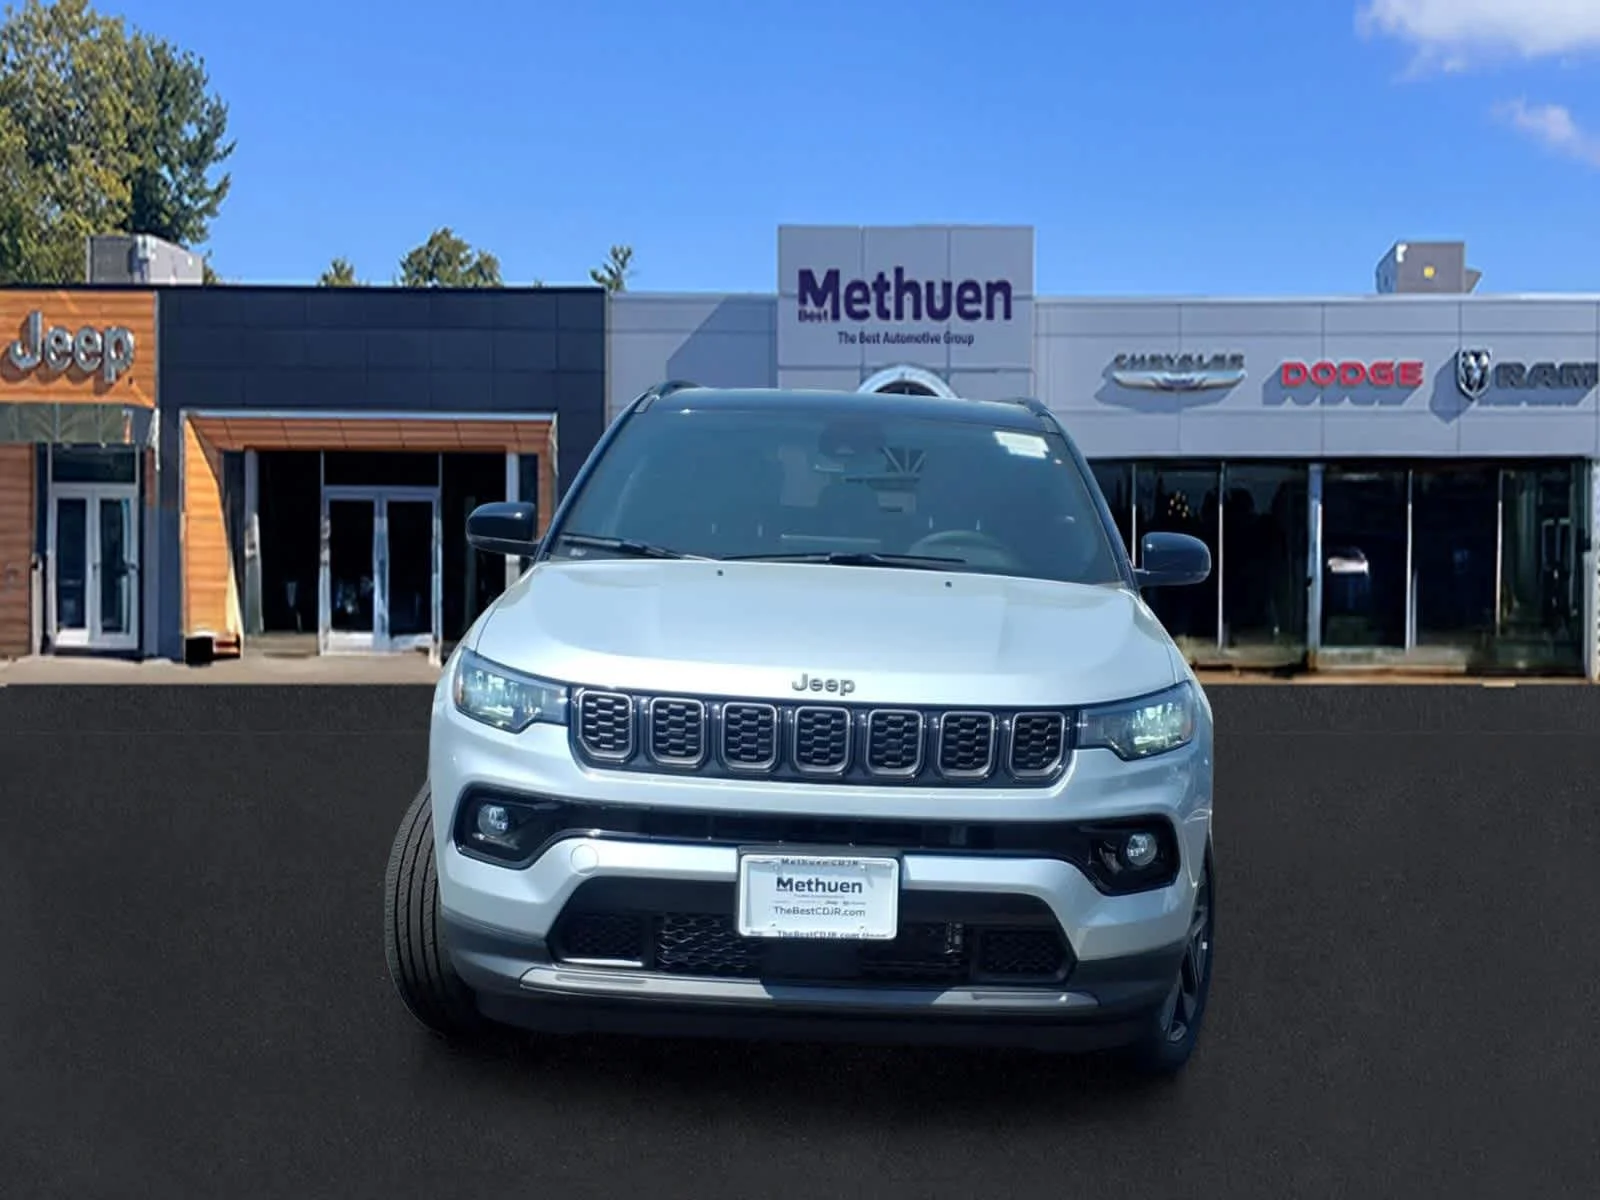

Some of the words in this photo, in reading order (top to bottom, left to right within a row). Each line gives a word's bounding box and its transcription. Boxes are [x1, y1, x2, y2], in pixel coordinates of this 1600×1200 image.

[798, 266, 1012, 321] Methuen
[798, 309, 828, 322] Best
[10, 310, 135, 384] Jeep
[838, 331, 857, 345] The
[859, 331, 880, 345] Best
[883, 331, 941, 345] Automotive
[943, 331, 974, 347] Group
[1114, 353, 1245, 370] CHRYSLER
[1281, 361, 1423, 386] DODGE
[1495, 362, 1598, 389] RAM
[791, 672, 856, 697] Jeep
[776, 877, 863, 893] Methuen
[774, 906, 866, 917] TheBestCDJR.com
